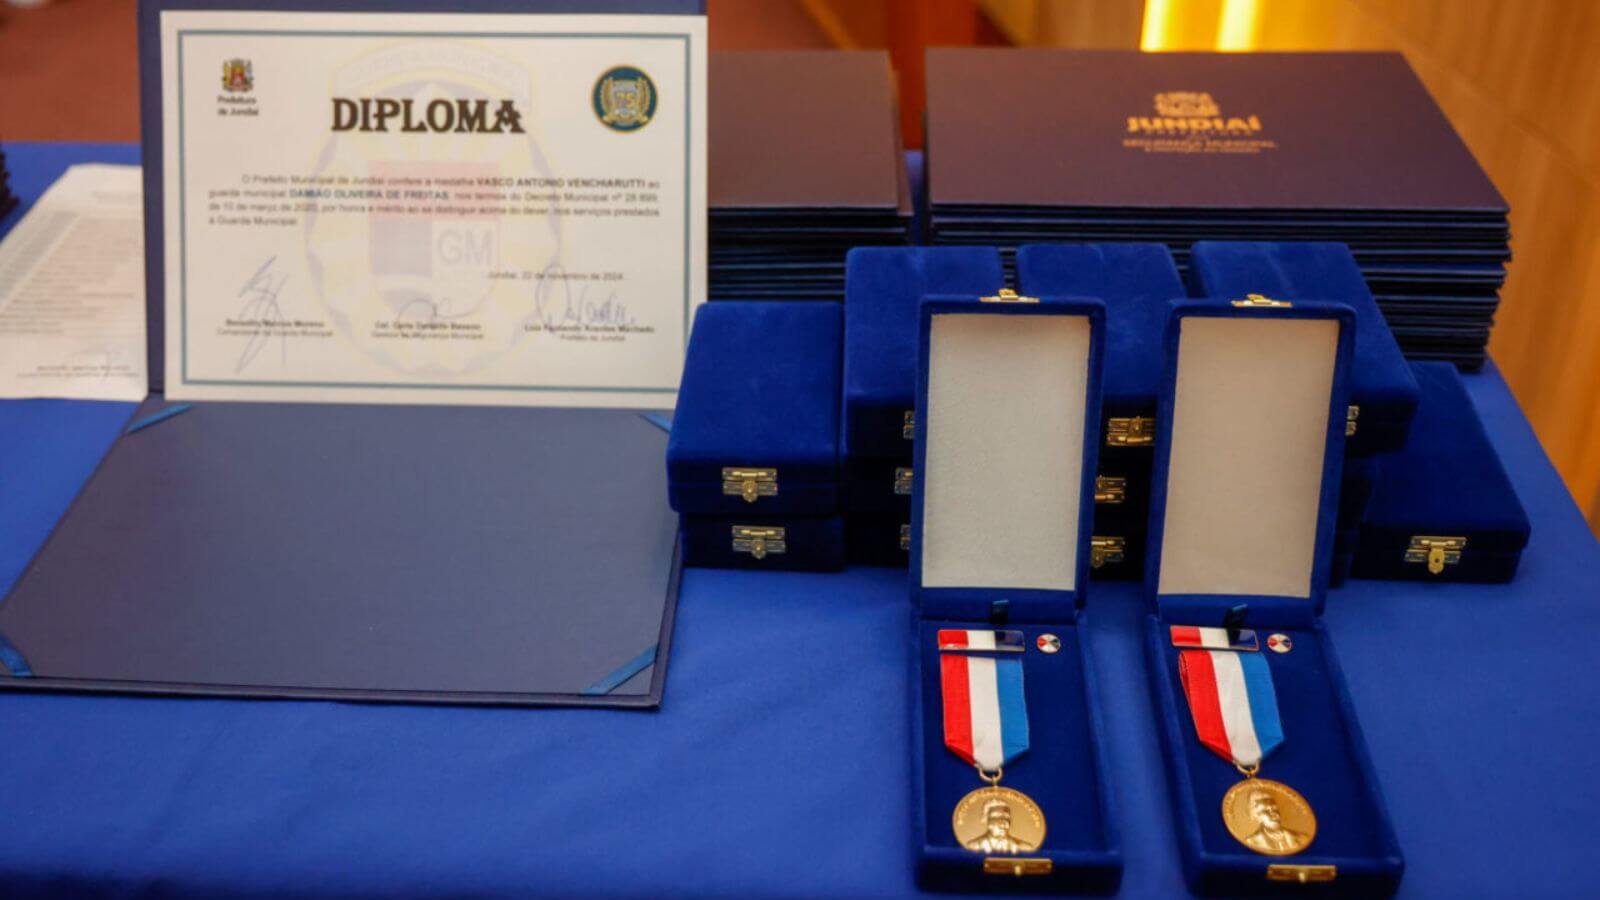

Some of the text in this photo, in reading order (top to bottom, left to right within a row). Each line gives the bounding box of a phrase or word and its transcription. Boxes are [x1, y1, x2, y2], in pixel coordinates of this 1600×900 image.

[331, 98, 526, 133] DIPLOMA
[1127, 115, 1262, 132] JUNDIAÍ
[253, 174, 288, 184] Prefeito
[290, 175, 334, 187] Municipal
[477, 177, 513, 187] VASCO
[517, 178, 565, 188] ANTONIO
[567, 178, 645, 189] VENCHIARUTTI
[335, 188, 382, 199] OLIVEIRA
[386, 190, 400, 200] DE
